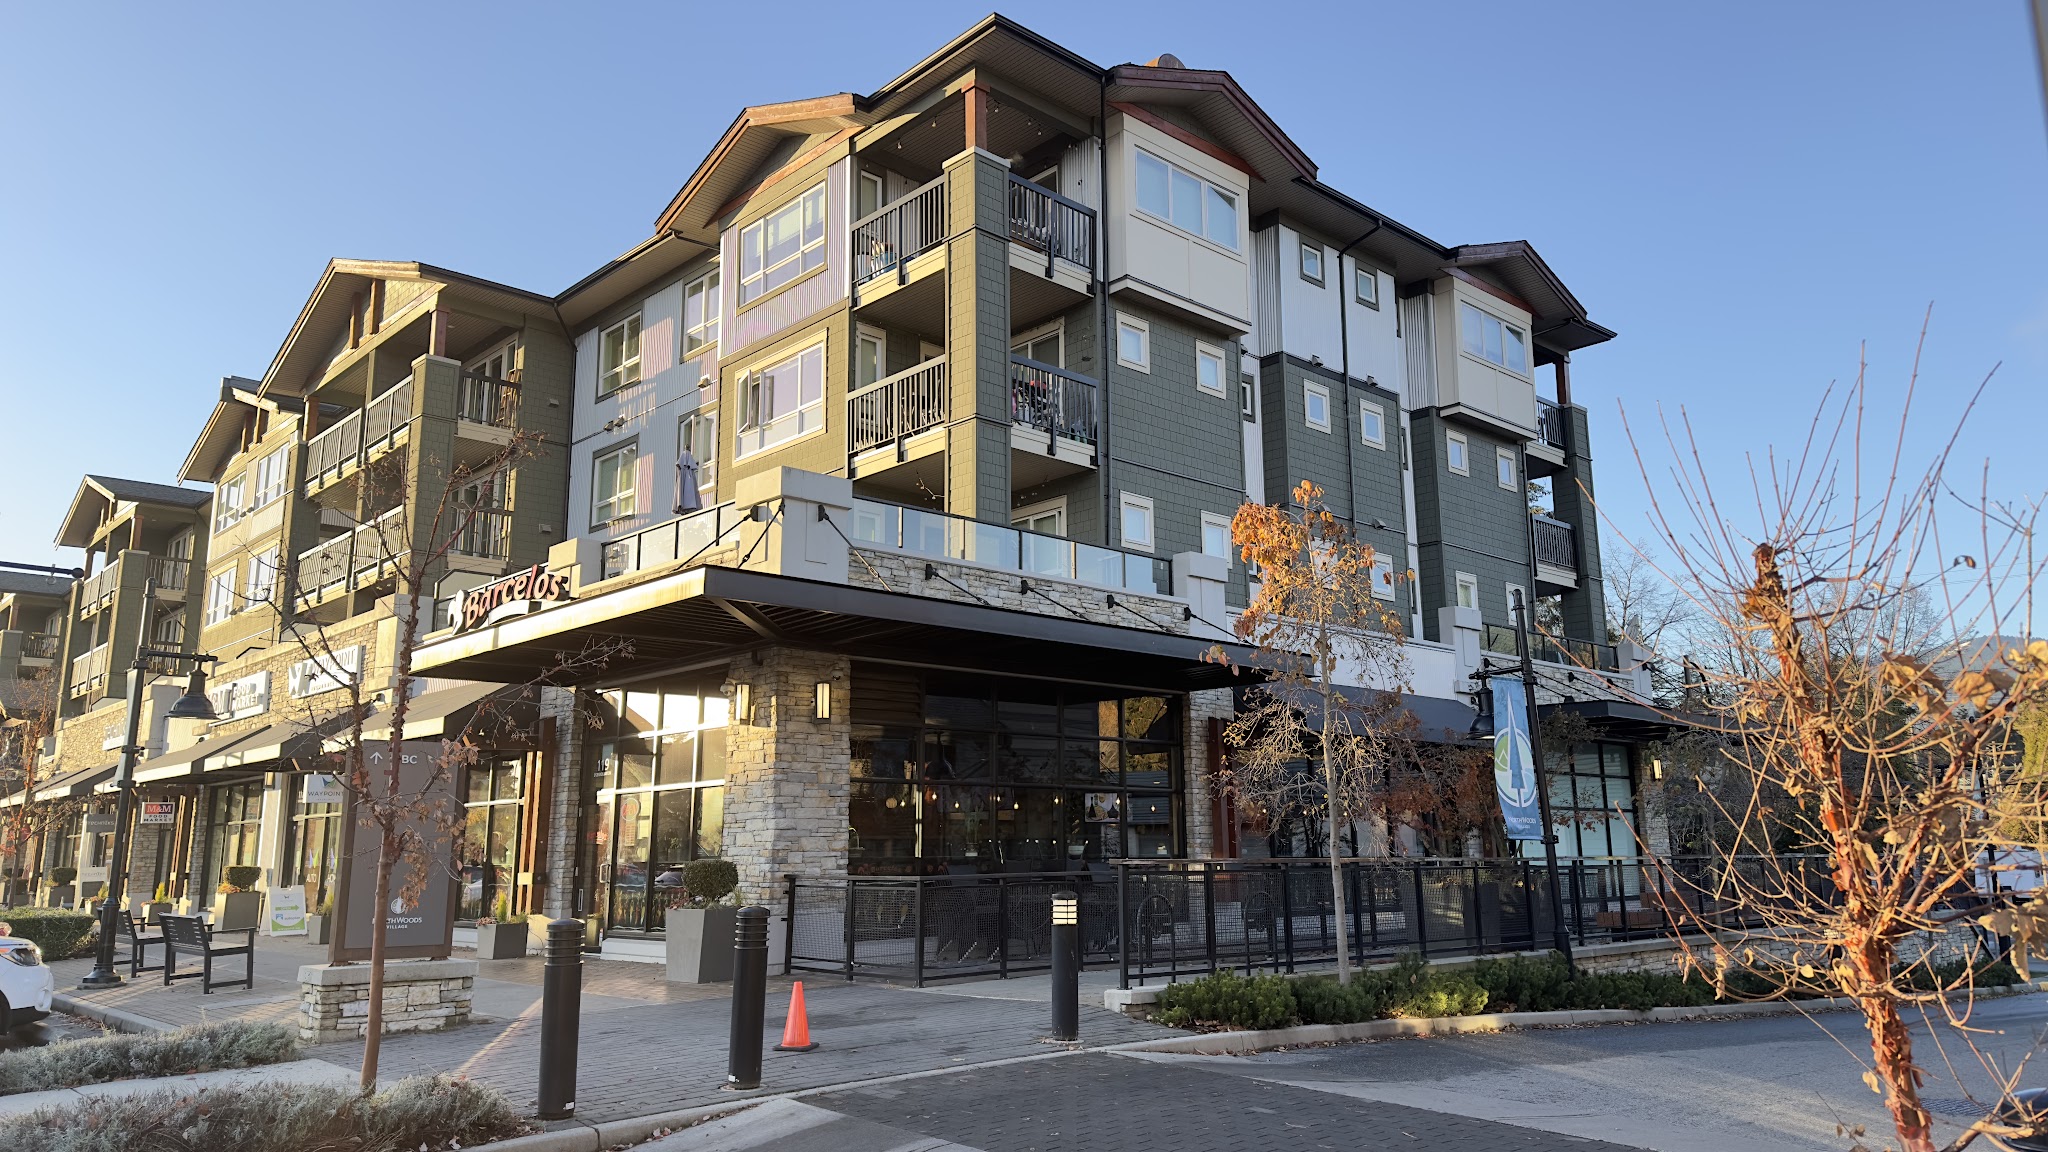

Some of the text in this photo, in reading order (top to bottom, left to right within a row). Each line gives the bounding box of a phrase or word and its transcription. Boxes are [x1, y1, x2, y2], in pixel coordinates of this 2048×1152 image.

[463, 564, 562, 629] Barcelos
[597, 758, 609, 772] 119
[147, 805, 172, 813] M&M
